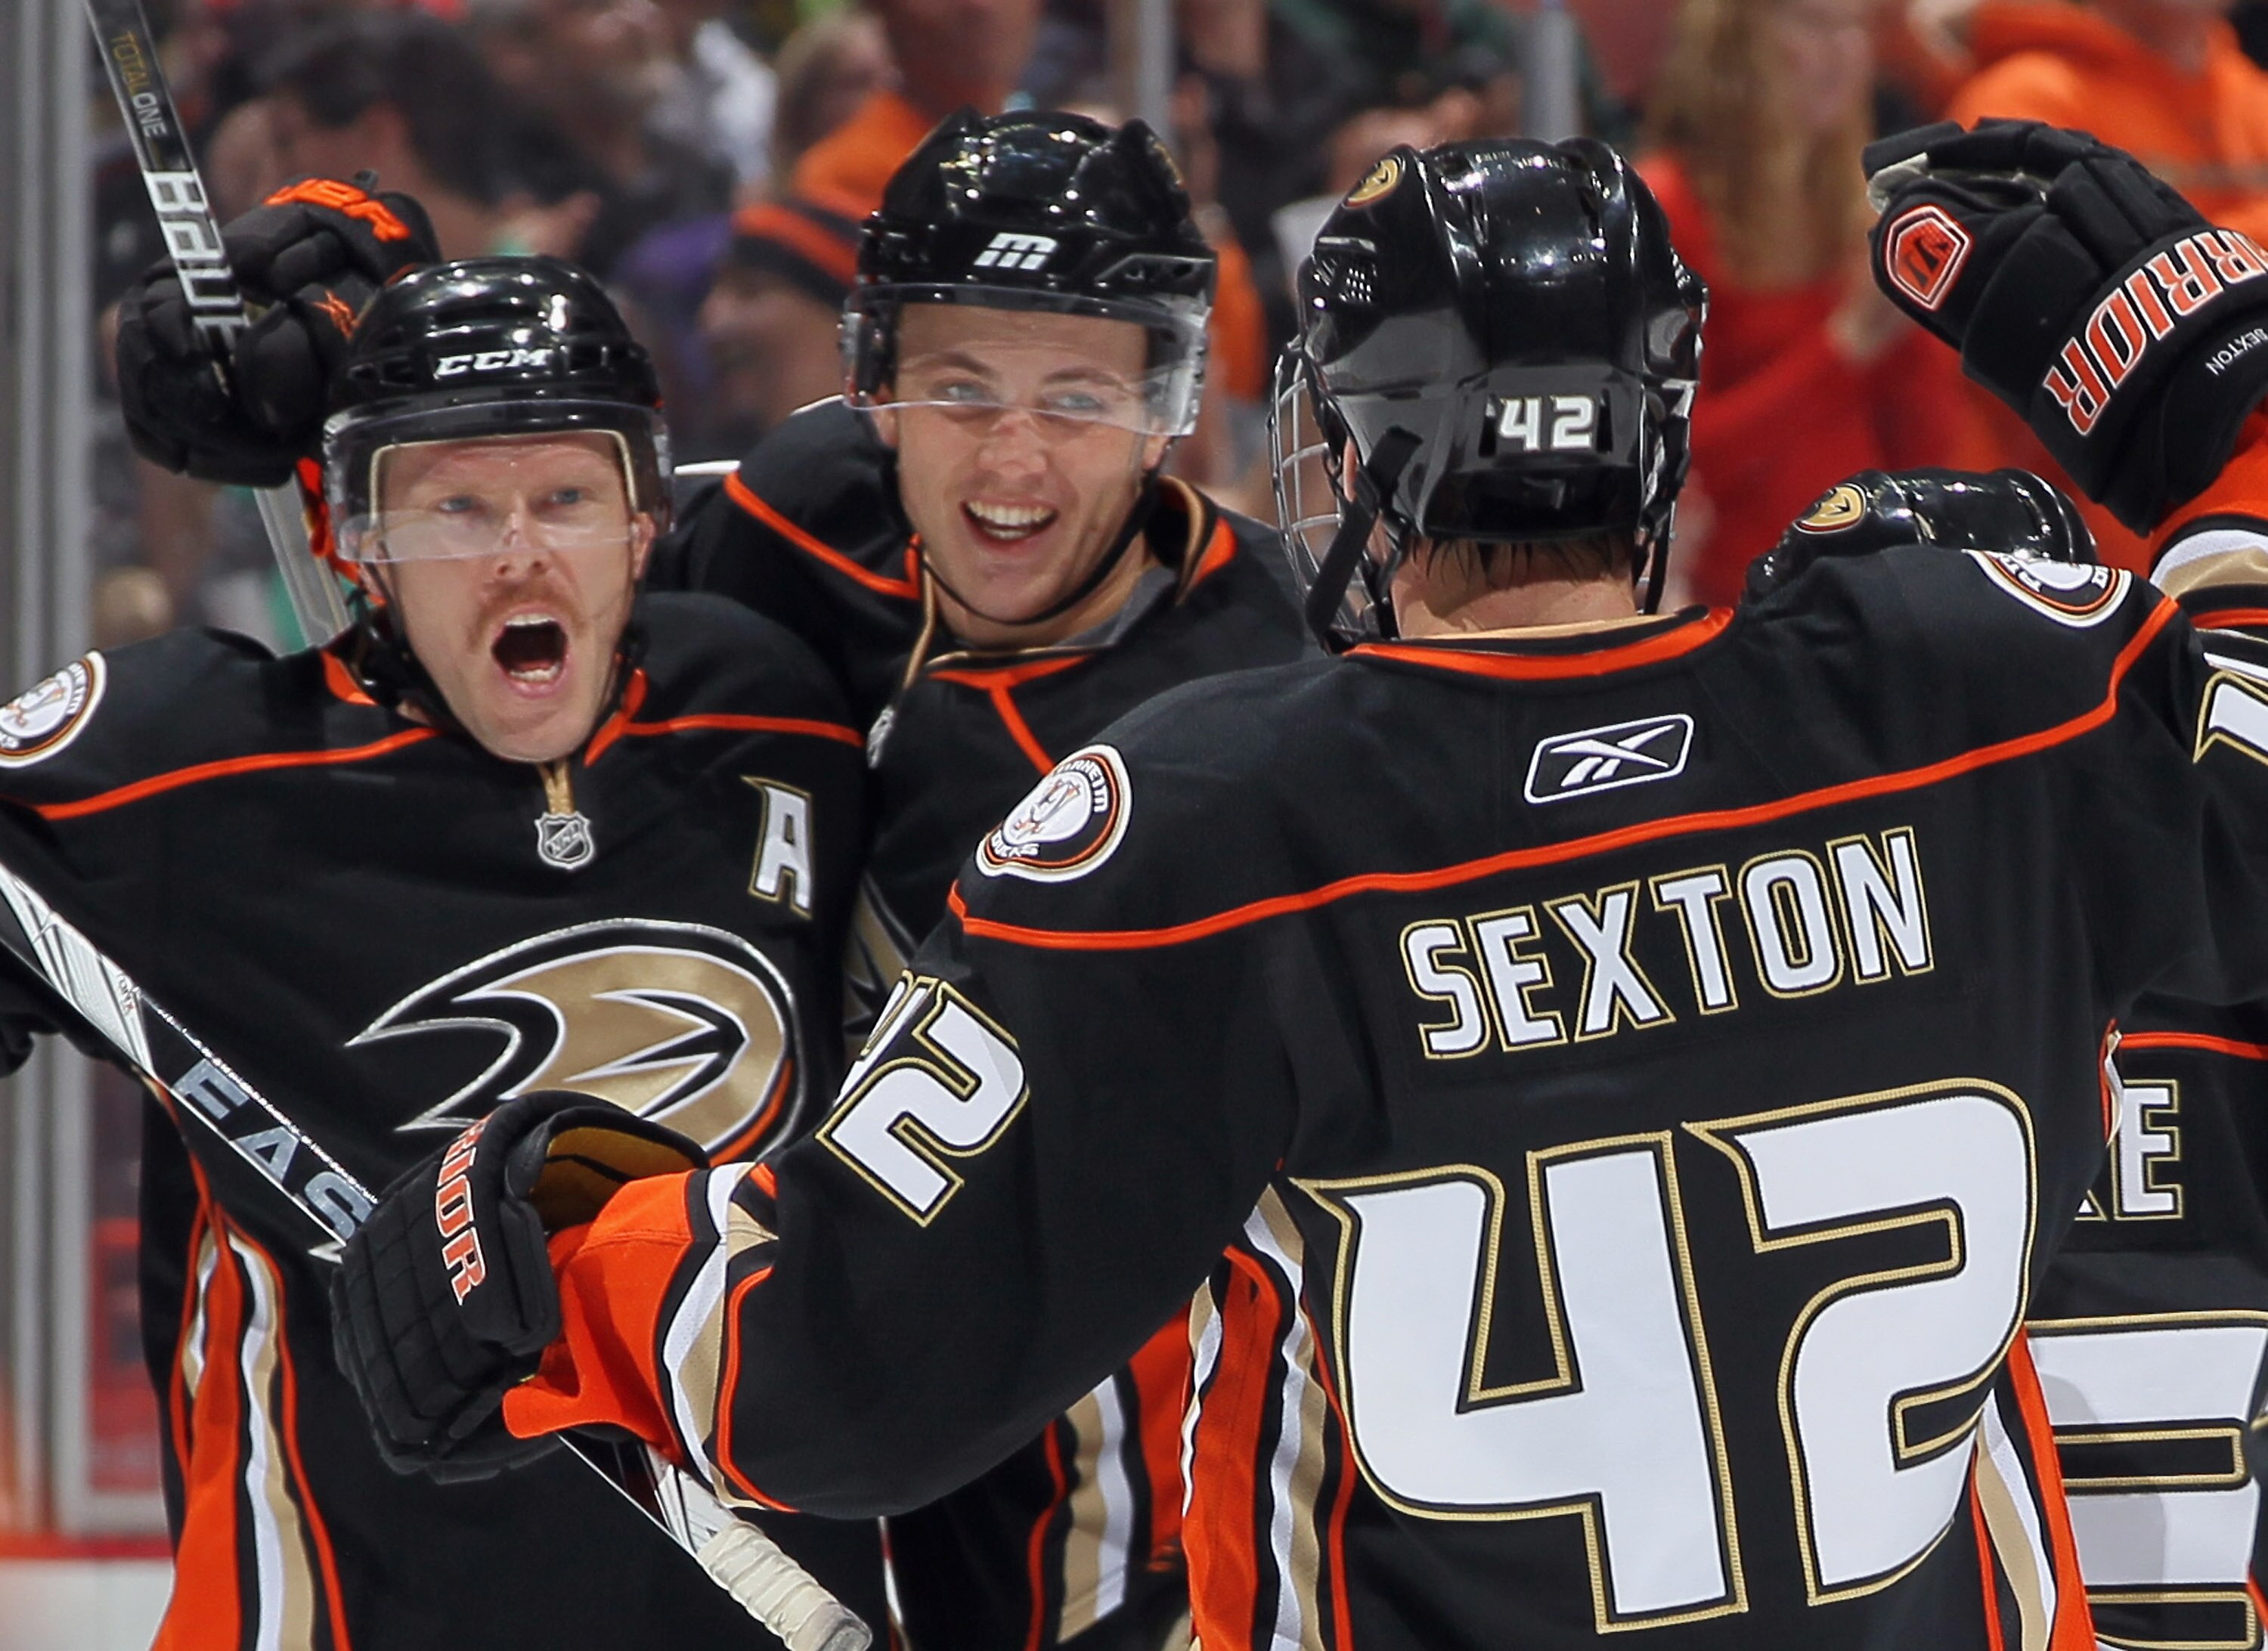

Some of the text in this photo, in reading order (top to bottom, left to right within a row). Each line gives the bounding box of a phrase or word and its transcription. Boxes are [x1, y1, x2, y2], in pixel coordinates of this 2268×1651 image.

[433, 348, 553, 379] CCM
[2042, 229, 2268, 435] RRIOR
[1500, 395, 1593, 451] 42
[742, 776, 813, 919] A
[1399, 826, 1935, 1059] SEXTON
[1288, 1076, 2037, 1634] 42
